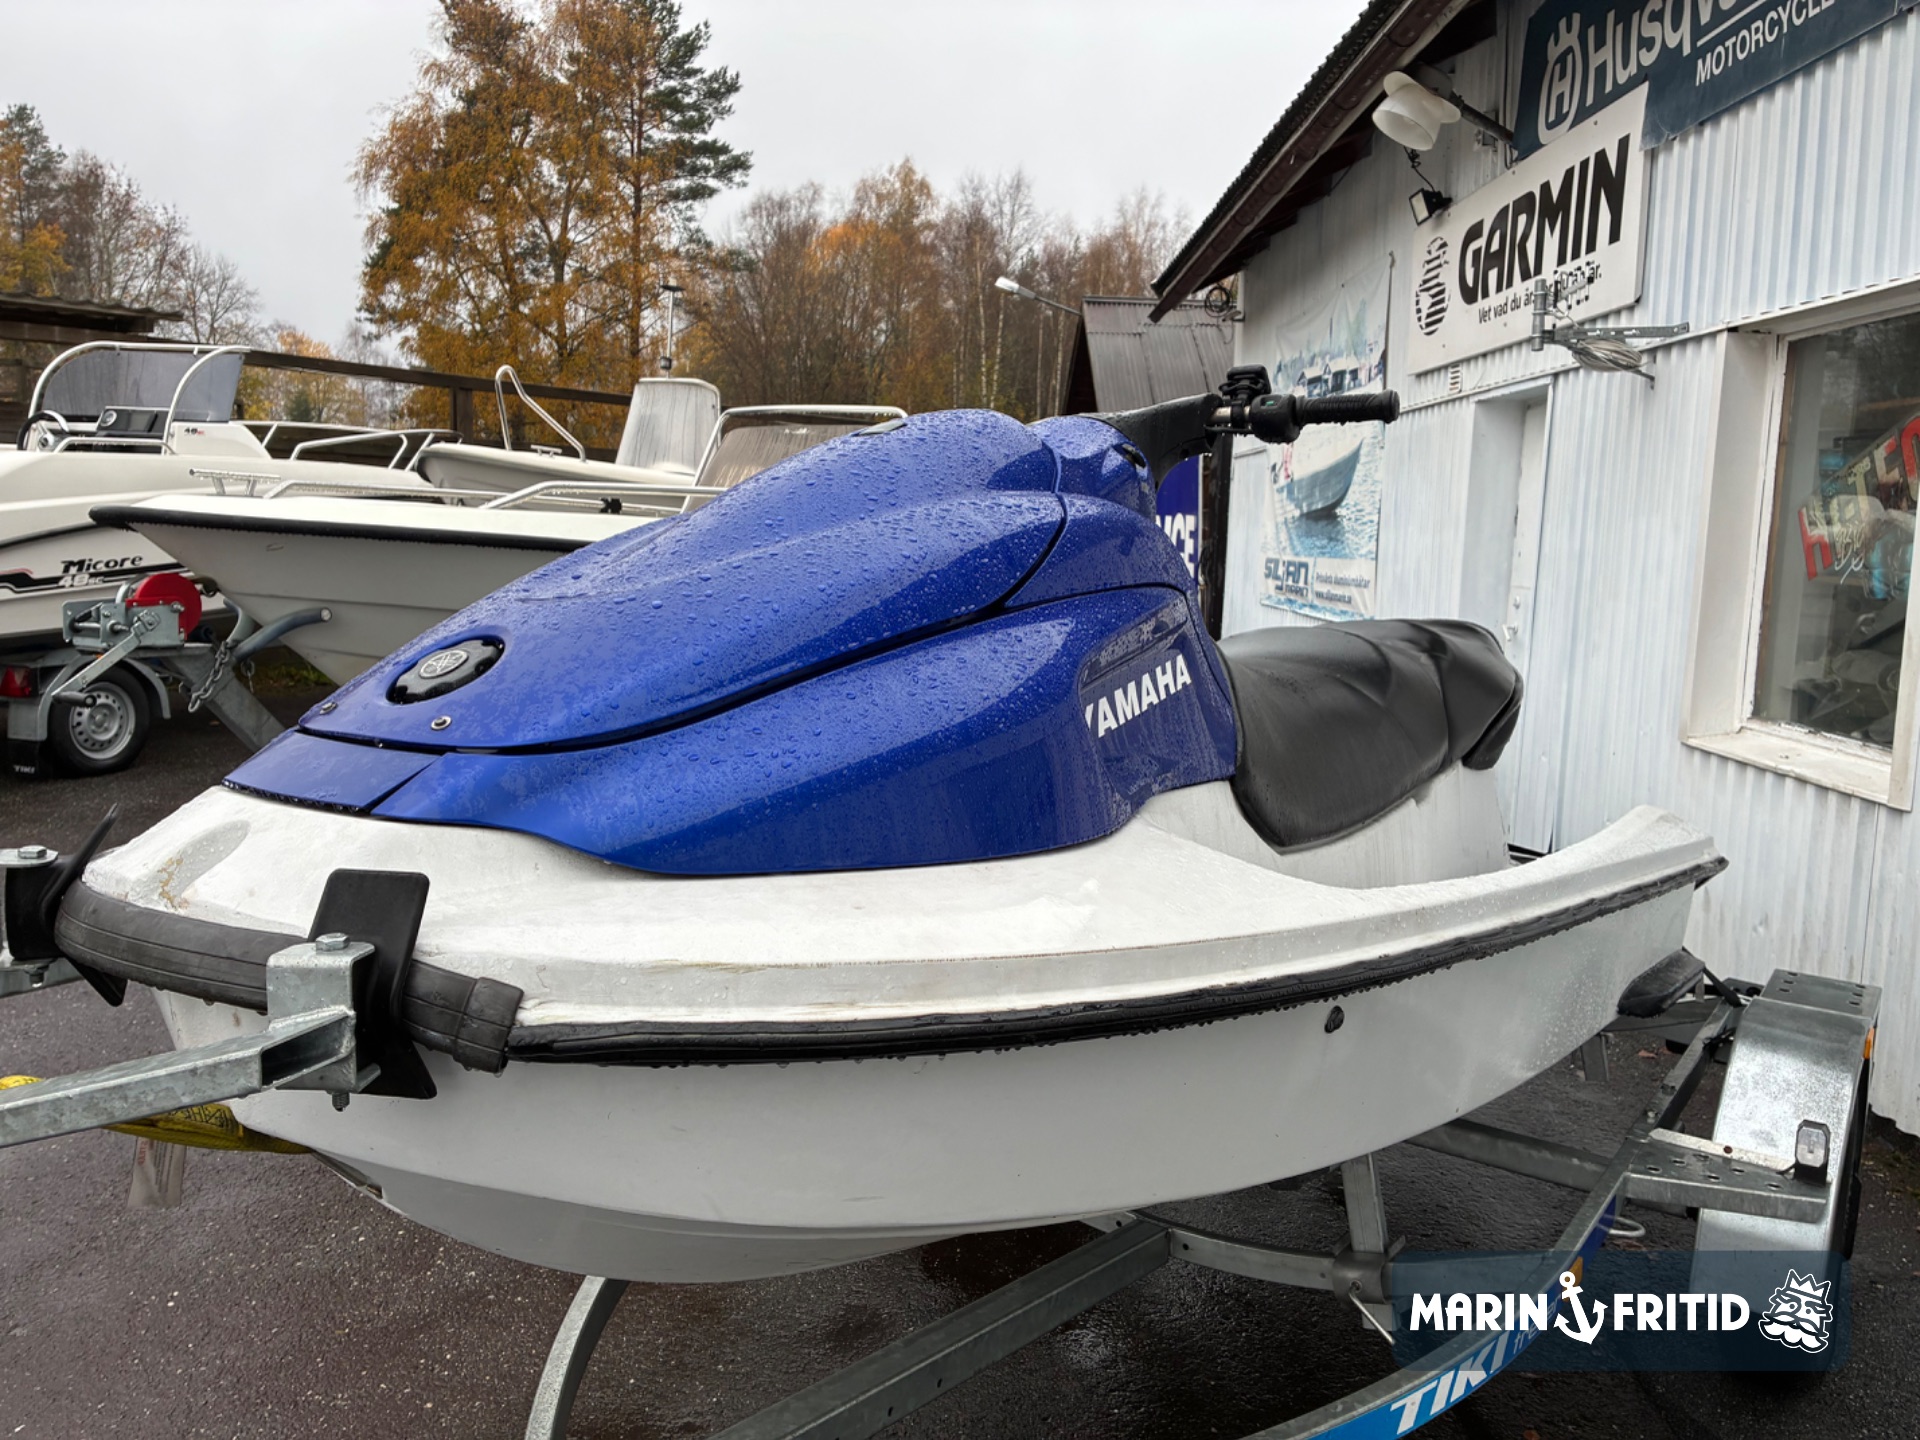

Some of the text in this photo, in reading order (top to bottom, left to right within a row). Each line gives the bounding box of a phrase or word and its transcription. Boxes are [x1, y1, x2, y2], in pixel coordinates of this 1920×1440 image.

[1585, 0, 1737, 107] Husq
[1458, 133, 1631, 306] GARMIN
[1478, 306, 1491, 324] Vet
[1493, 296, 1508, 319] vad
[1510, 291, 1522, 312] du
[61, 555, 143, 575] Micore
[1389, 1328, 1511, 1436] TIKI
